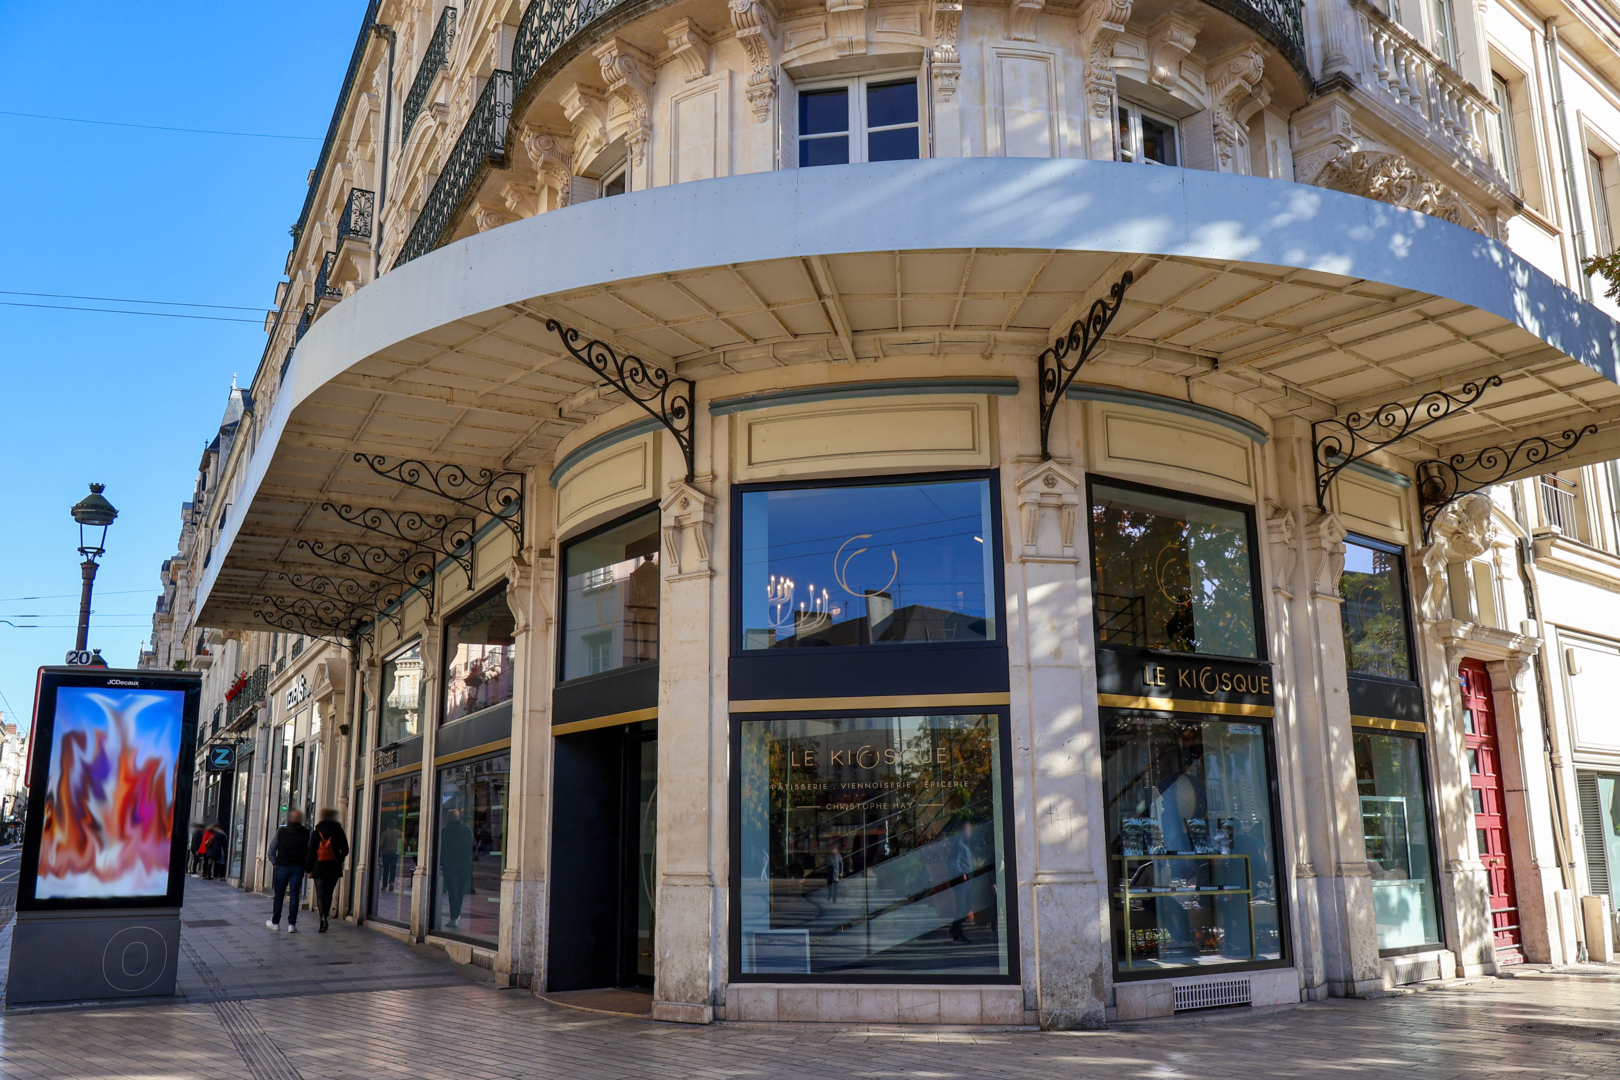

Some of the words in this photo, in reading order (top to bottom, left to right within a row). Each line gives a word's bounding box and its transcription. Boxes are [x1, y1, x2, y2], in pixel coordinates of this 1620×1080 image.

[67, 651, 91, 665] 20
[1144, 665, 1166, 686] LE
[1178, 666, 1270, 695] KIOSQUE
[214, 748, 230, 764] Z
[790, 750, 814, 767] LE
[830, 744, 947, 770] KIOSQUE
[840, 781, 911, 790] VIENNOISERIE
[825, 802, 888, 811] CHRISTOPHE
[892, 802, 913, 810] HAY
